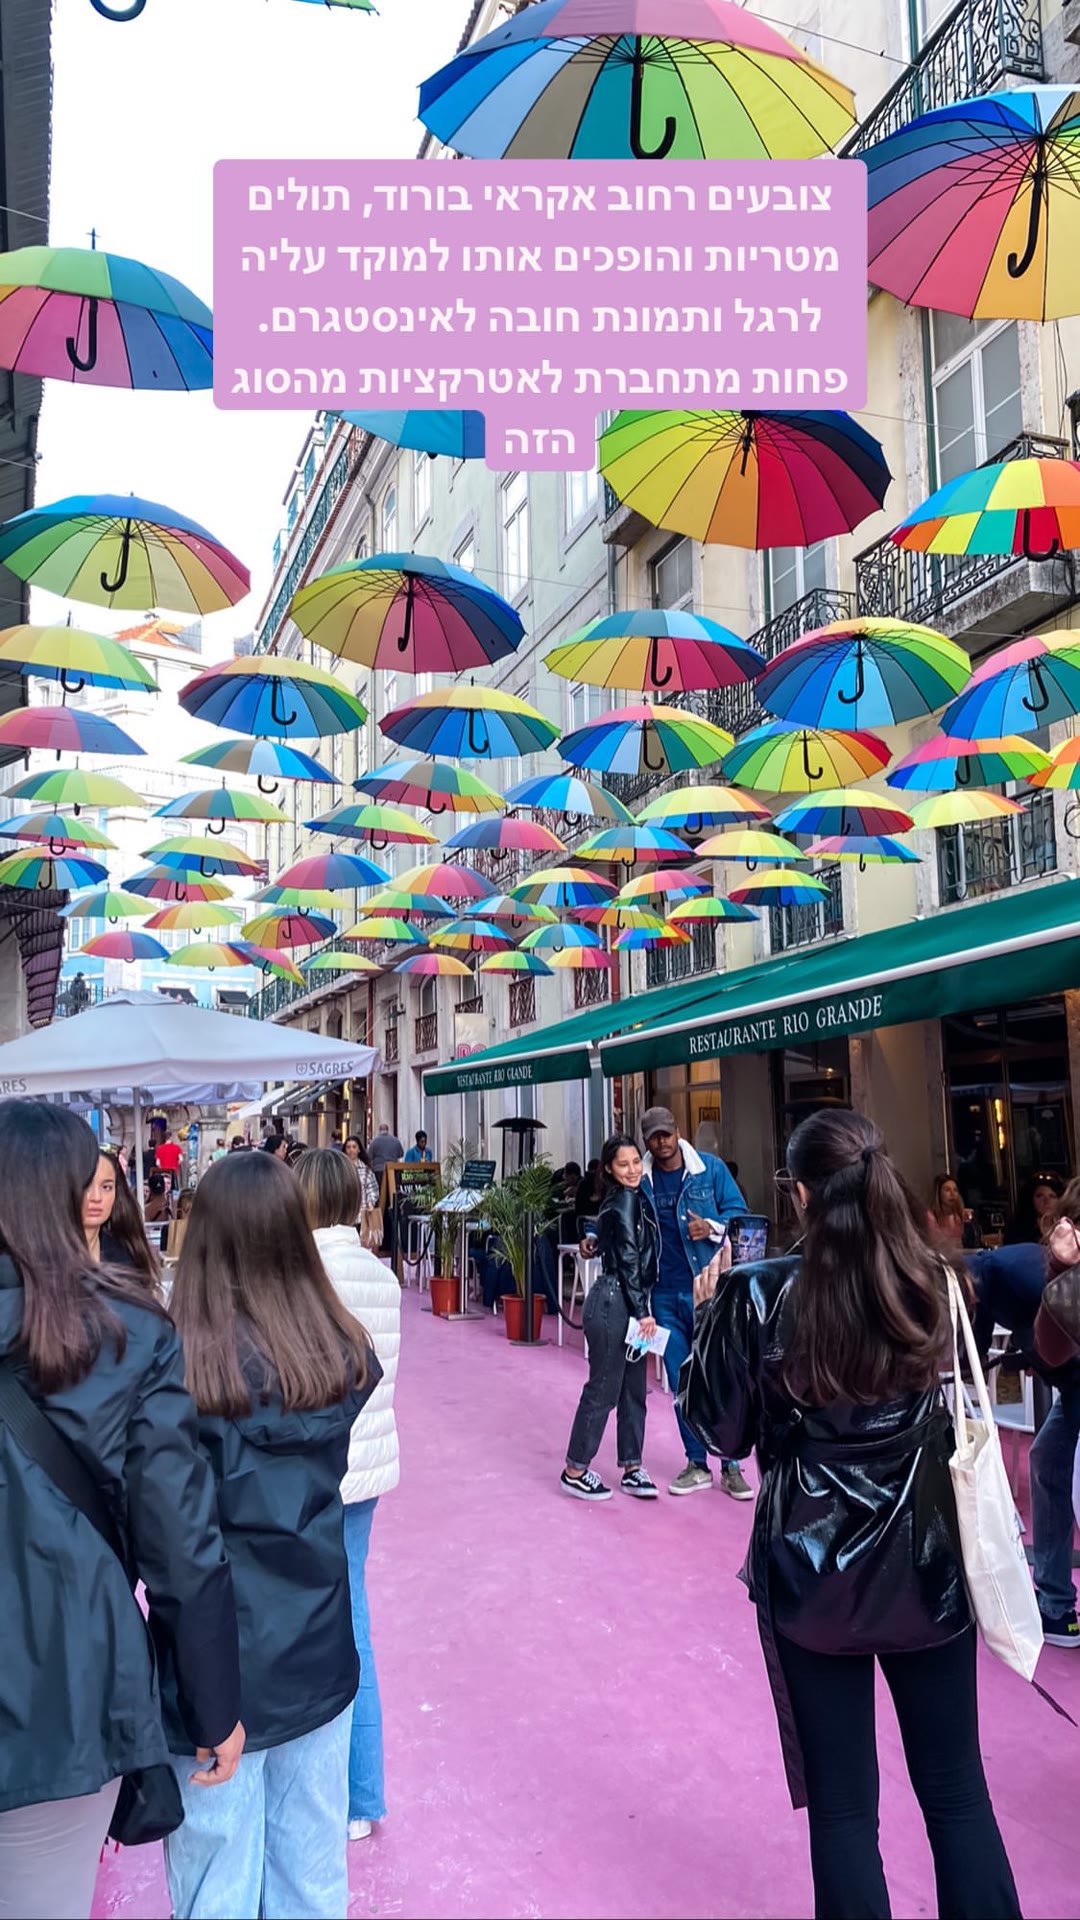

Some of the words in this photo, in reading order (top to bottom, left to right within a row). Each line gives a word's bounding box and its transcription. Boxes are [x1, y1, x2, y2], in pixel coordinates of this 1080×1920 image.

[689, 1020, 777, 1054] RESTAURANTE
[783, 1012, 809, 1036] RIO
[816, 995, 883, 1029] GRANDE
[309, 1060, 354, 1075] SAGRES
[457, 1071, 492, 1088] RESTAURANTE
[506, 1065, 533, 1081] GRANDE
[0, 1078, 28, 1094] RES
